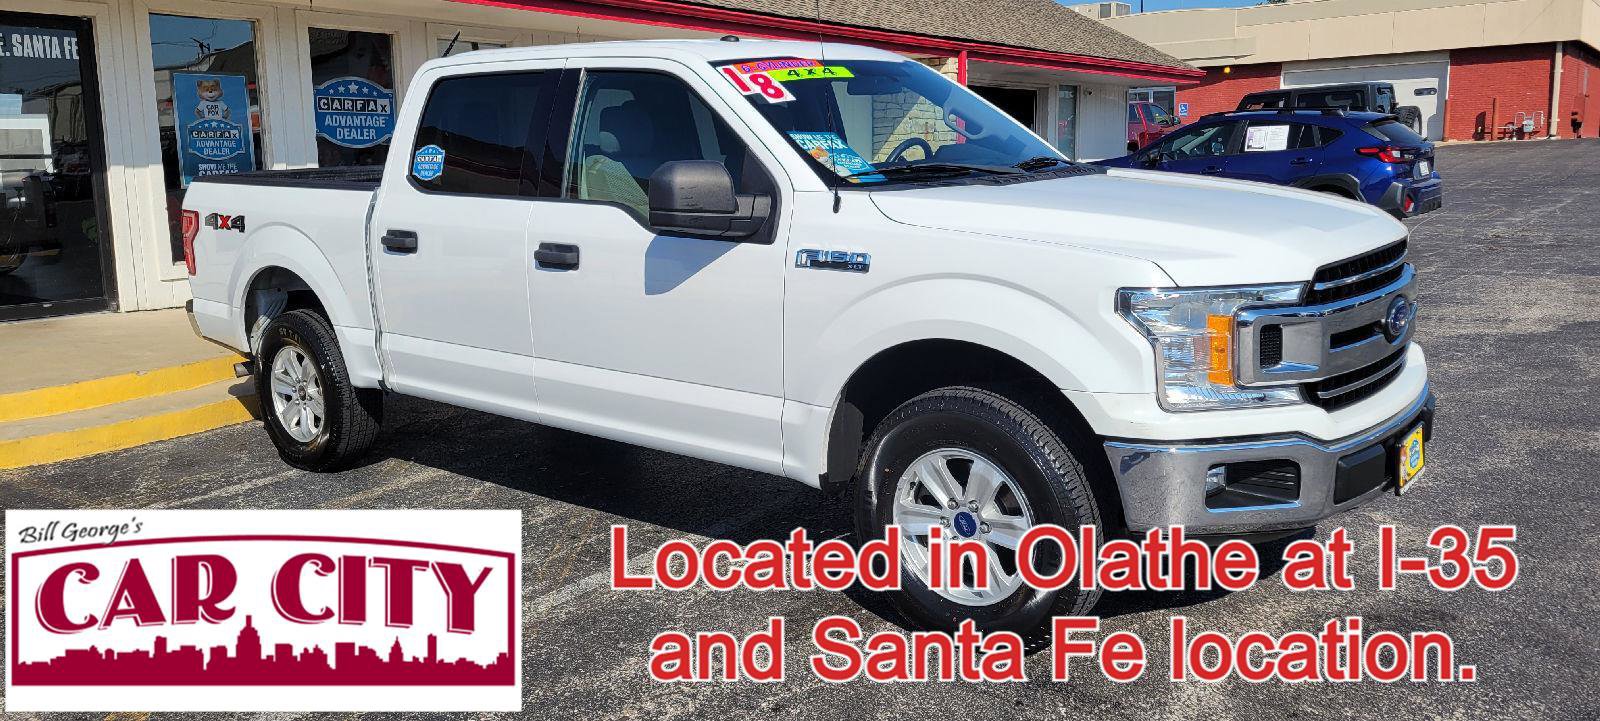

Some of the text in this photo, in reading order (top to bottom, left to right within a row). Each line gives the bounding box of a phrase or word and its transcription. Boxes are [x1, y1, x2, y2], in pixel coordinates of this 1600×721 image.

[11, 33, 61, 59] SANTA
[63, 36, 80, 60] FE
[722, 67, 785, 99] 18
[318, 97, 389, 114] CARFAX
[324, 114, 386, 127] ADVANTAGE
[192, 131, 239, 139] CARFAX
[336, 128, 377, 140] DEALER
